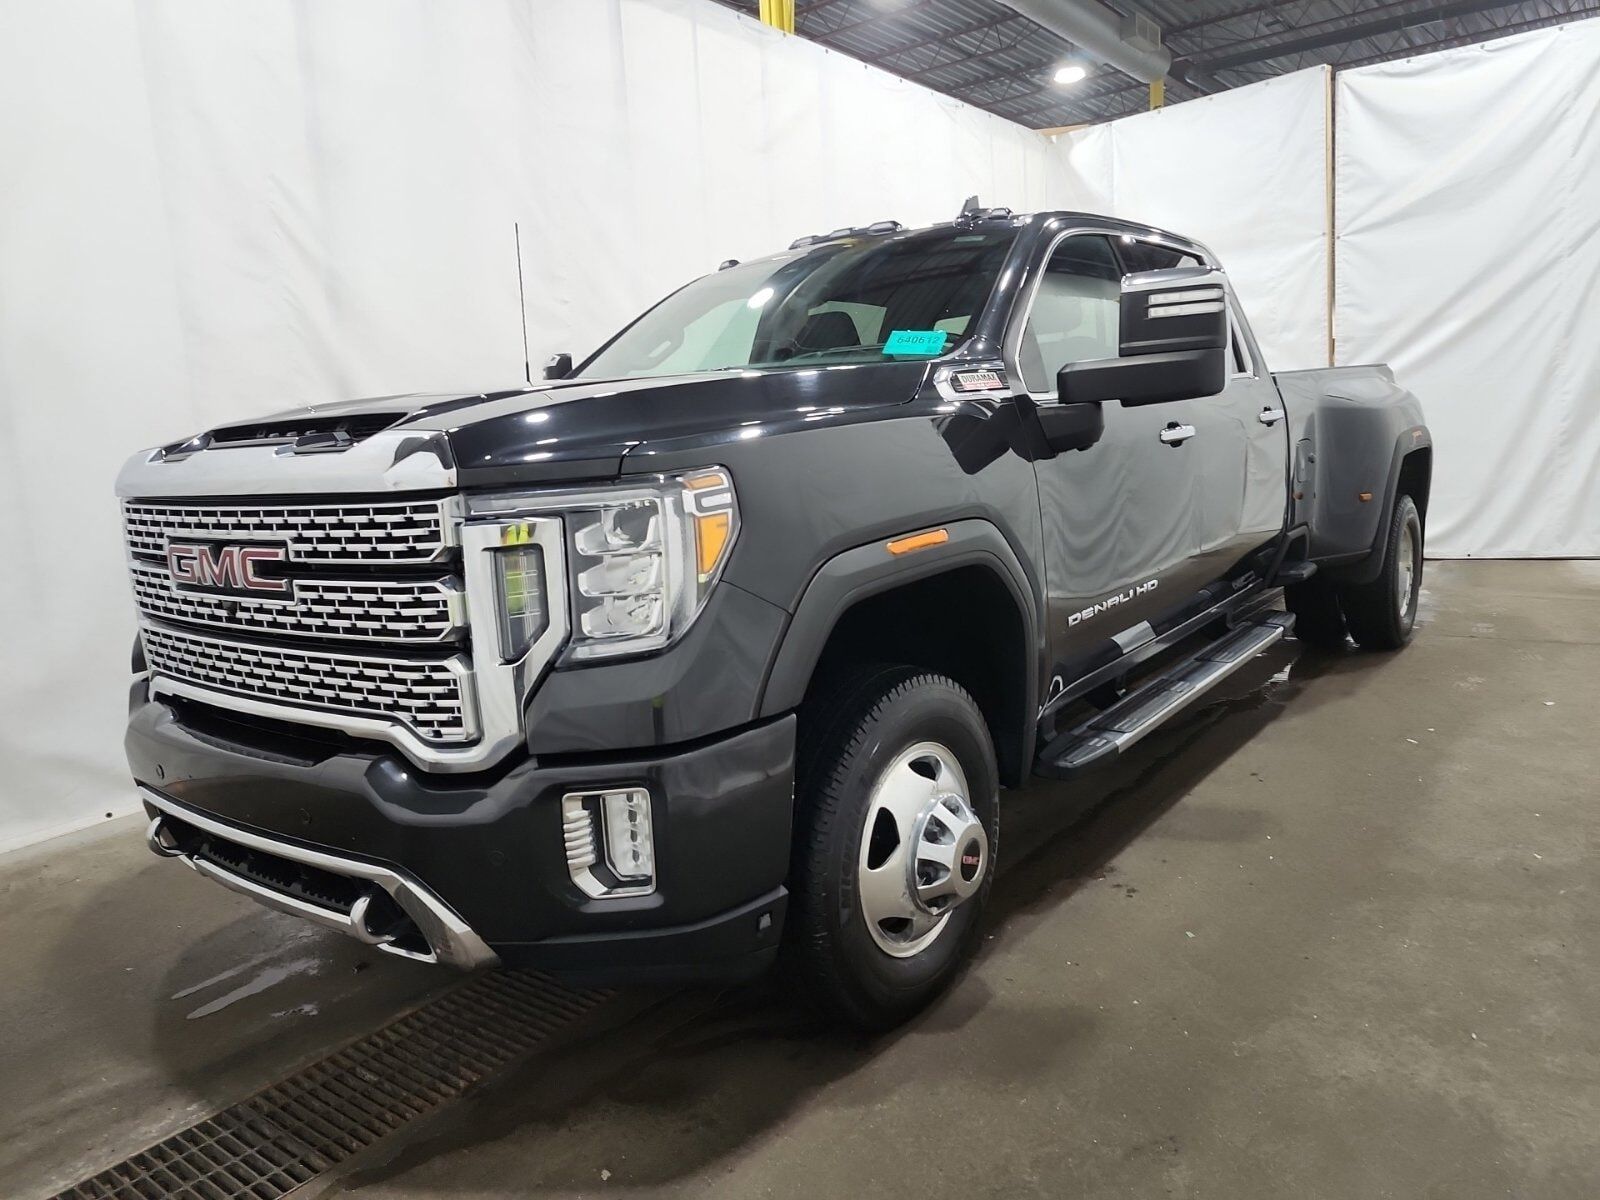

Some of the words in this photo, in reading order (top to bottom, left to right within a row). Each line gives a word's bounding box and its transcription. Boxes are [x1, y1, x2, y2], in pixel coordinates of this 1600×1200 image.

[897, 336, 940, 344] 640612
[960, 373, 996, 383] DURAMAX
[168, 544, 287, 591] GMC
[1067, 589, 1134, 627] DENALI
[1136, 579, 1159, 597] HD
